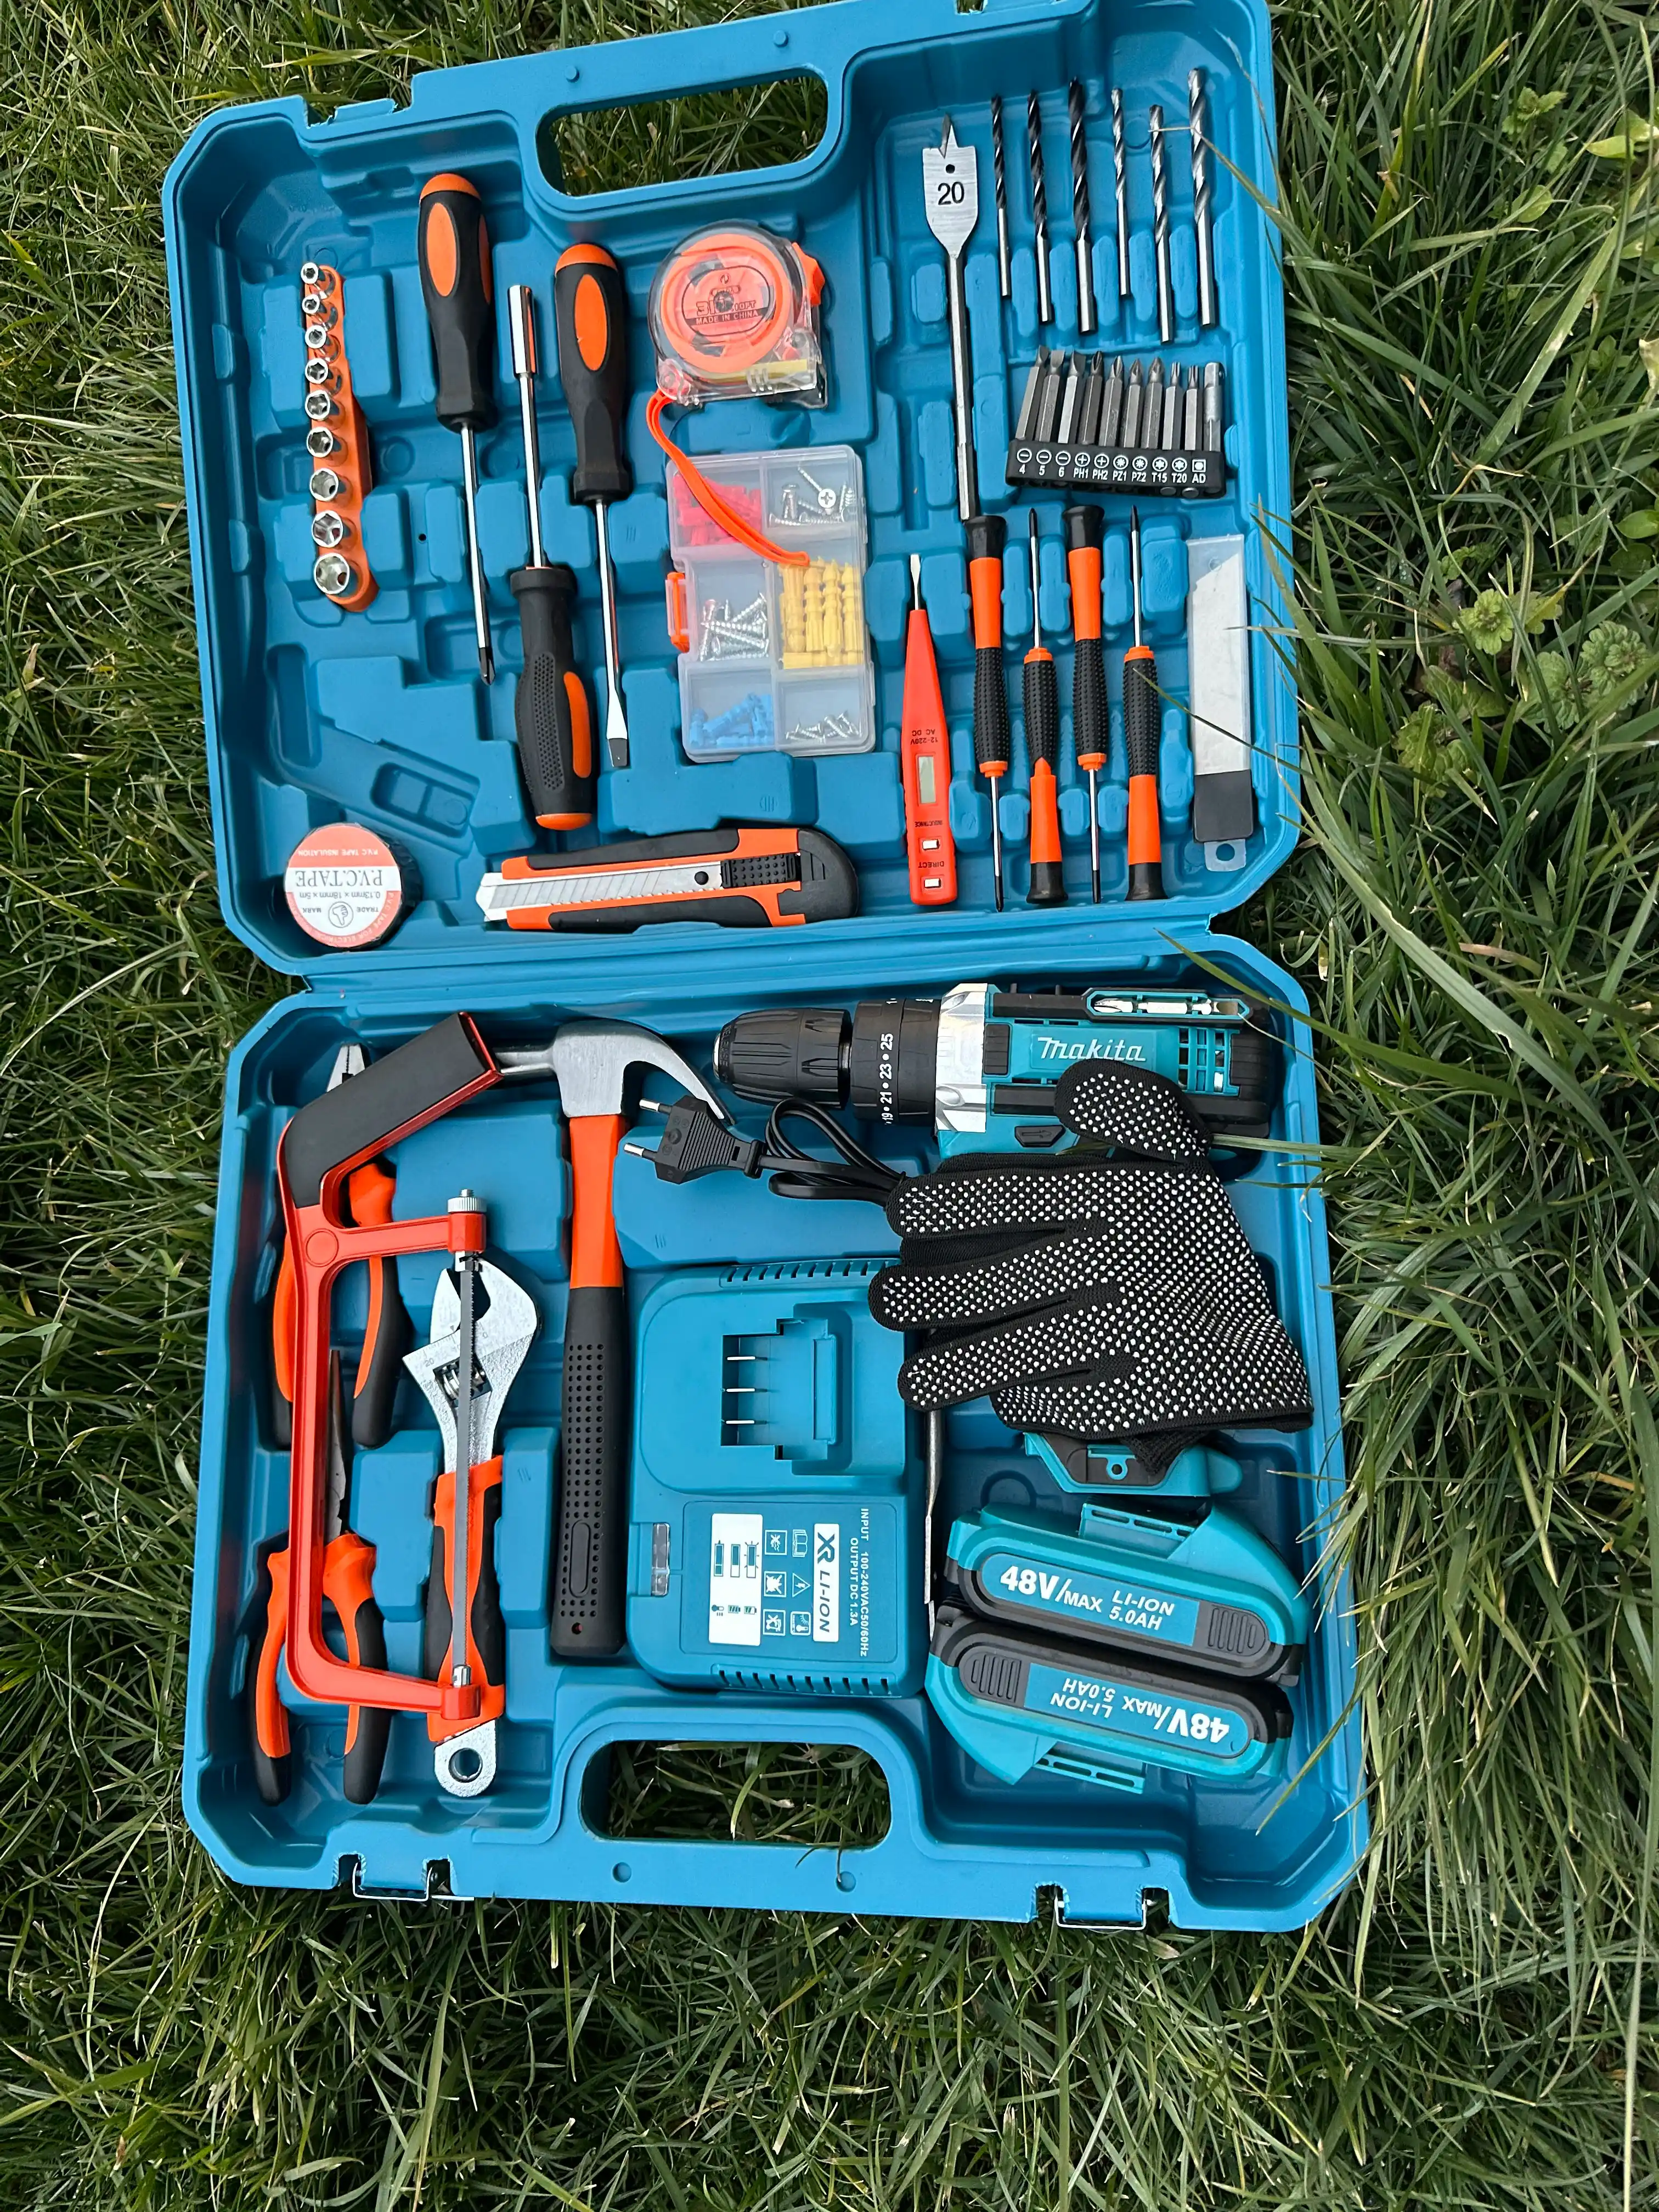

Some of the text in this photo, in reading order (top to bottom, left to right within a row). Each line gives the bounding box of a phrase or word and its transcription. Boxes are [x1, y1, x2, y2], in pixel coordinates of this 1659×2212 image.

[938, 181, 965, 205] 20
[696, 317, 719, 325] MADE
[733, 310, 758, 319] CHINA
[1019, 464, 1206, 484] 4 5 6 PH1 PH2 PZ1 PZ2 T15 T20 AD
[357, 928, 373, 939] FOR
[879, 1033, 894, 1121] 19 21 23 25
[860, 1508, 869, 1541] INPUT
[817, 1532, 835, 1633] XR LI-ION
[850, 1537, 859, 1626] OUTPUT DC 1.3A
[1111, 1589, 1175, 1617] LI-ION
[1108, 1605, 1163, 1631] 5.0AH
[1063, 1677, 1116, 1702] 5.0AH
[1050, 1691, 1113, 1718] LI-ION
